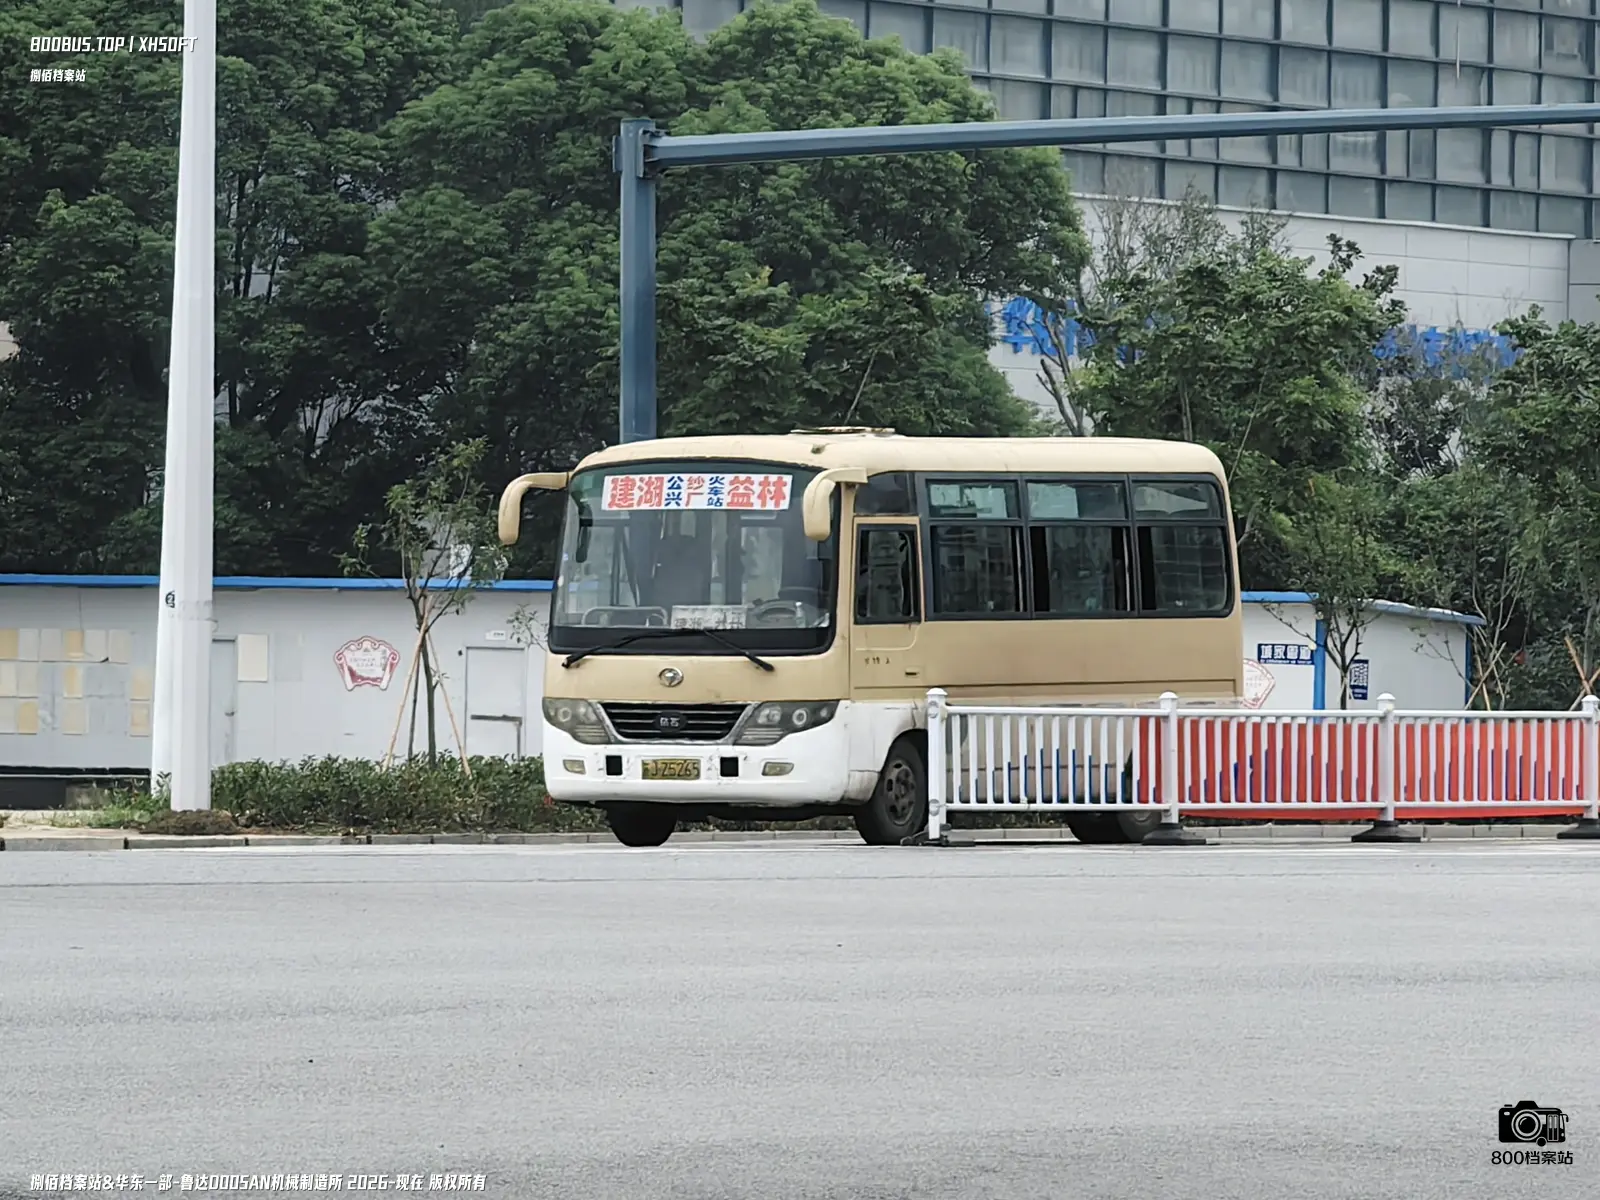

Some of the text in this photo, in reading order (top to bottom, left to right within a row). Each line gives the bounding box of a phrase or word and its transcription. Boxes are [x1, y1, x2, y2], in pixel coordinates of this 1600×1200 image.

[607, 475, 788, 509] 建湖 公兴 纱厂 火车站 益林
